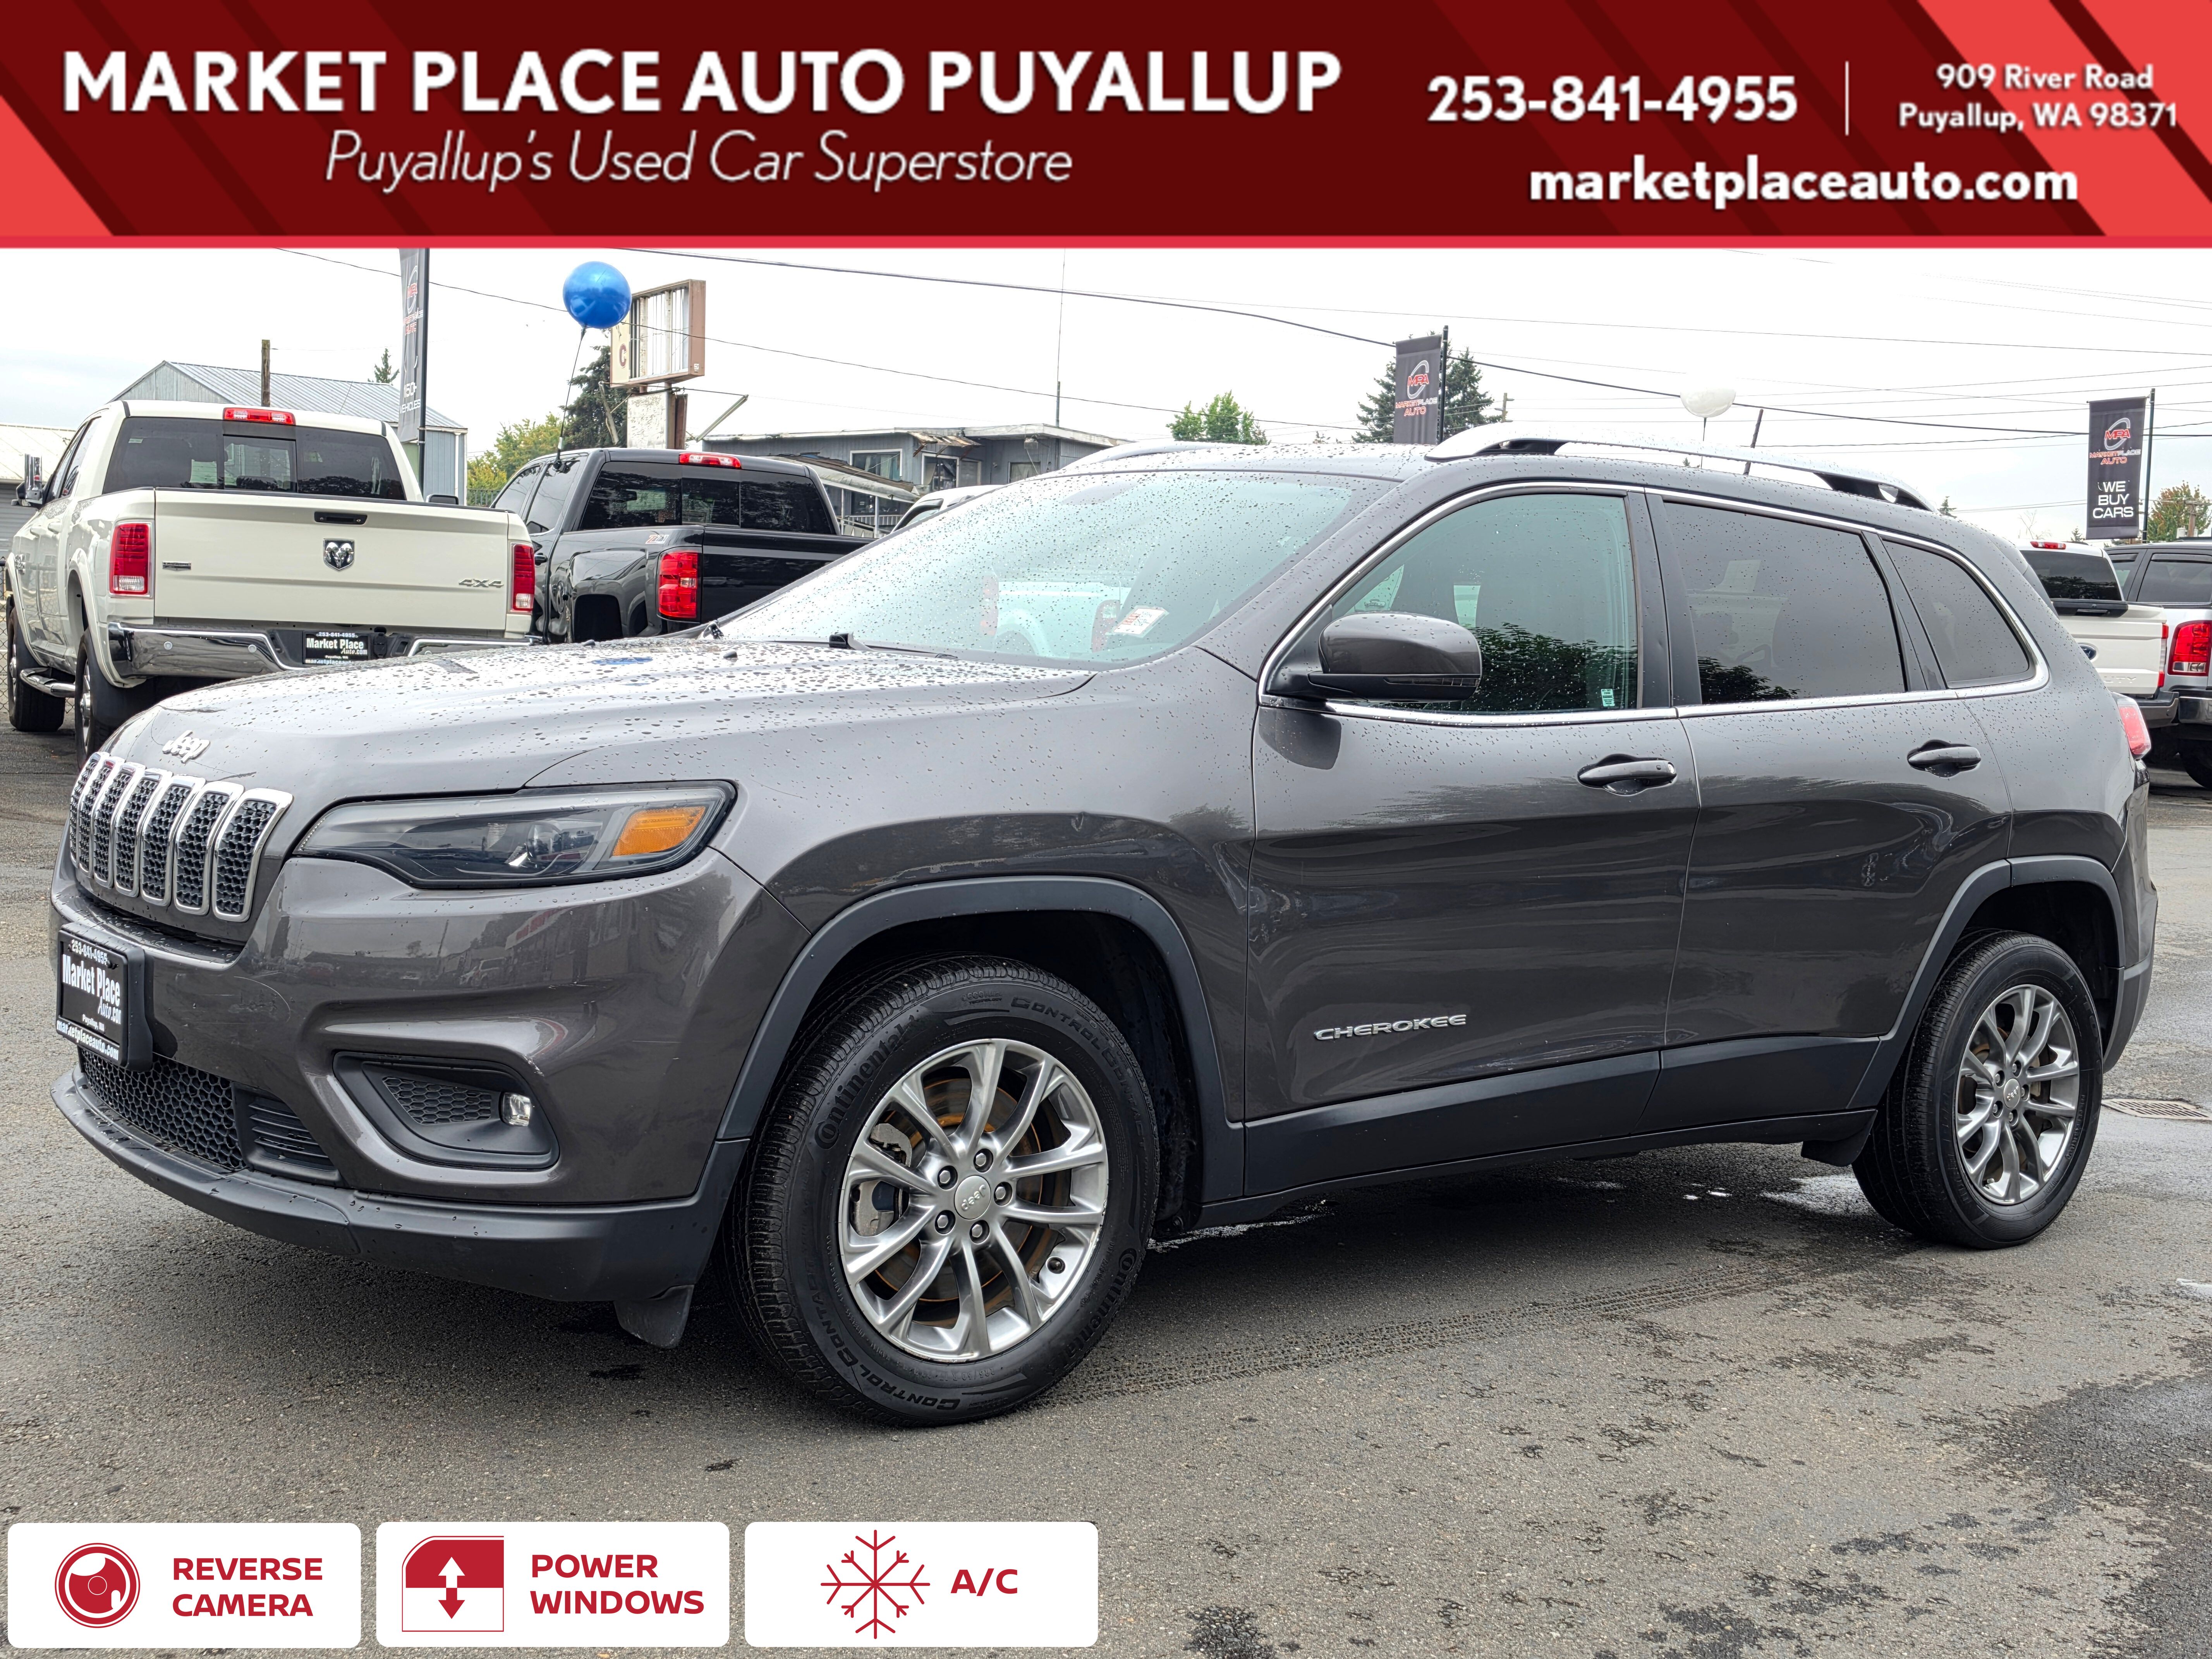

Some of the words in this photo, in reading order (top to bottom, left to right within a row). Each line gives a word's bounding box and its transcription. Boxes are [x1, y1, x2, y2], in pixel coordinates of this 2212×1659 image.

[1404, 406, 1426, 416] AUTO
[2100, 457, 2127, 465] AUTO
[2102, 481, 2126, 493] WE
[2098, 494, 2130, 506] BUY
[2093, 507, 2134, 519] CARS
[645, 534, 669, 544] Z71
[306, 638, 337, 649] Market
[340, 639, 364, 649] Place
[162, 730, 210, 763] Jeep
[72, 939, 108, 966] 253-841-4955
[62, 954, 95, 994] Market
[97, 968, 120, 1006] Place
[1314, 1014, 1467, 1040] CHEROKEE
[57, 1020, 118, 1060] marketplaceauto.com
[962, 1185, 986, 1211] Jeep
